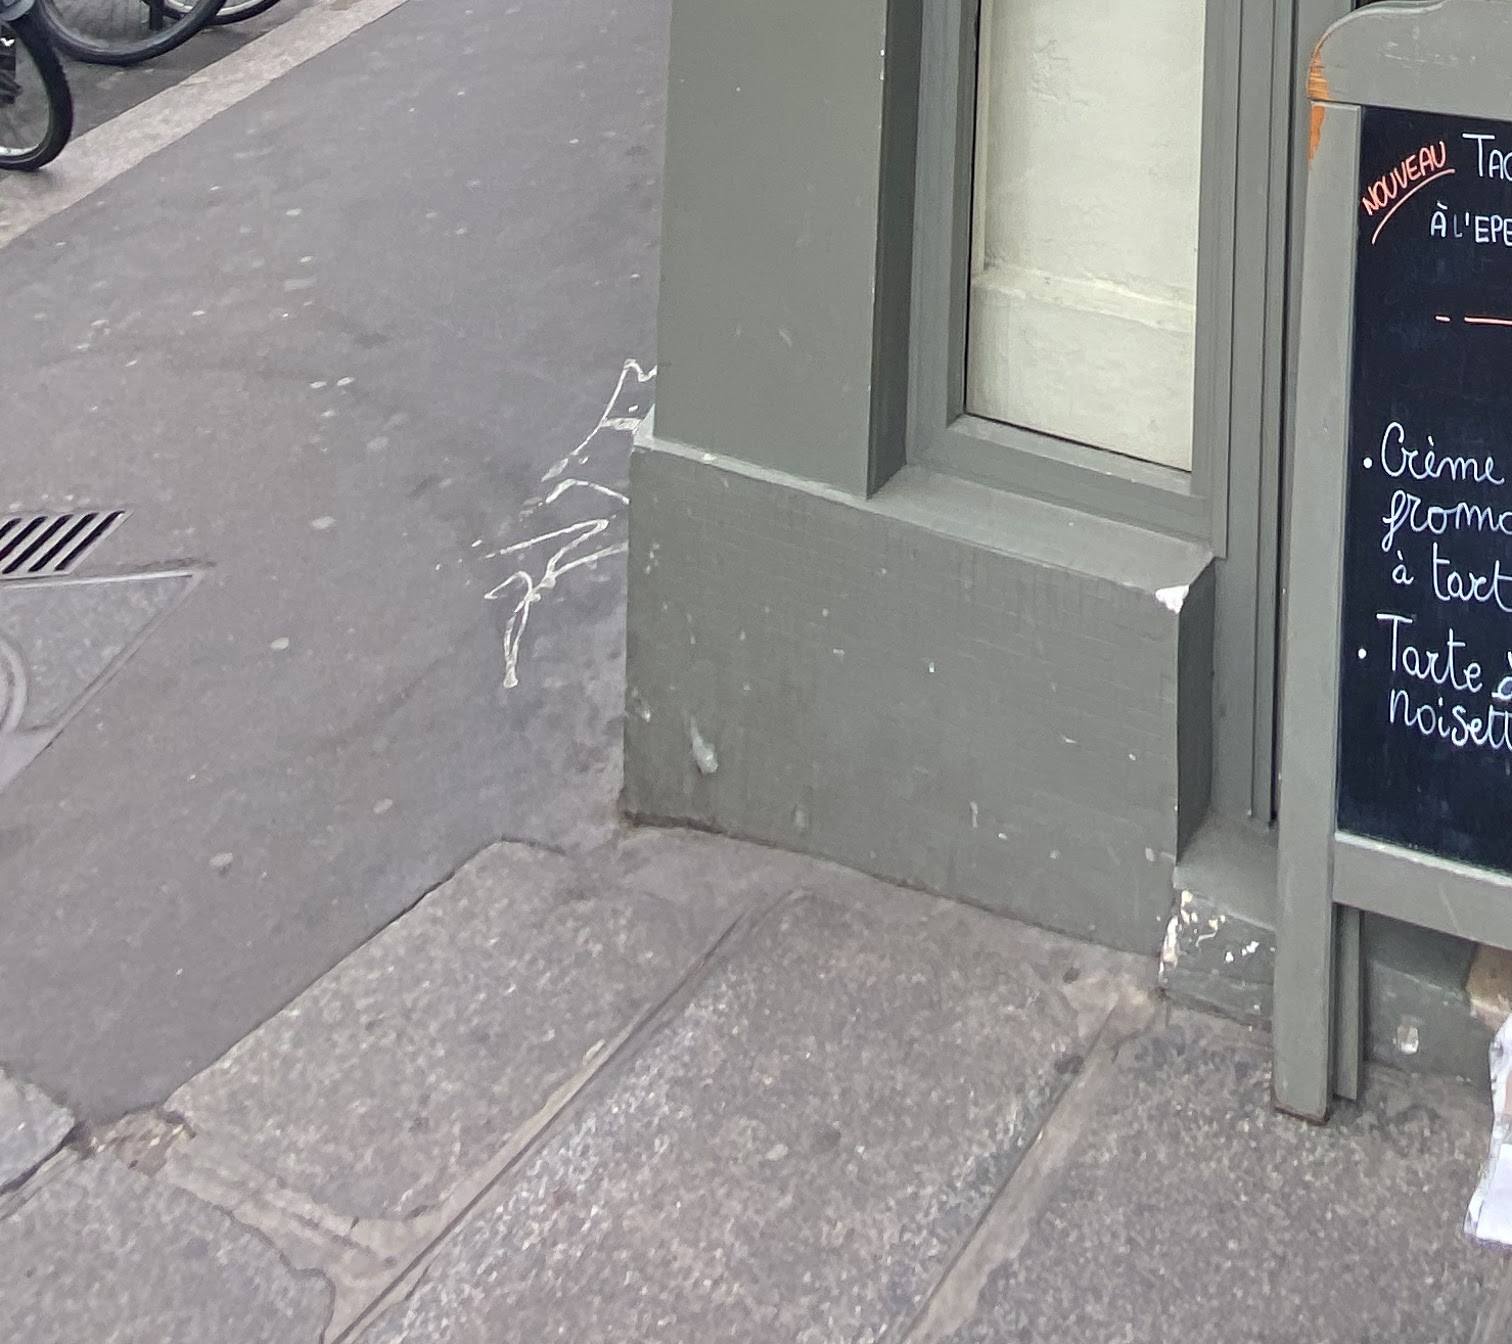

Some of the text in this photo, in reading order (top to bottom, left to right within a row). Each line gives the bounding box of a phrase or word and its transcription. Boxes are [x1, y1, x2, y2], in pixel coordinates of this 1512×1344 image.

[1361, 141, 1446, 216] NOUVEAU
[1430, 201, 1448, 237] À
[1381, 421, 1505, 485] Crème
[1392, 550, 1415, 585] à
[1376, 613, 1484, 692] Tarte
